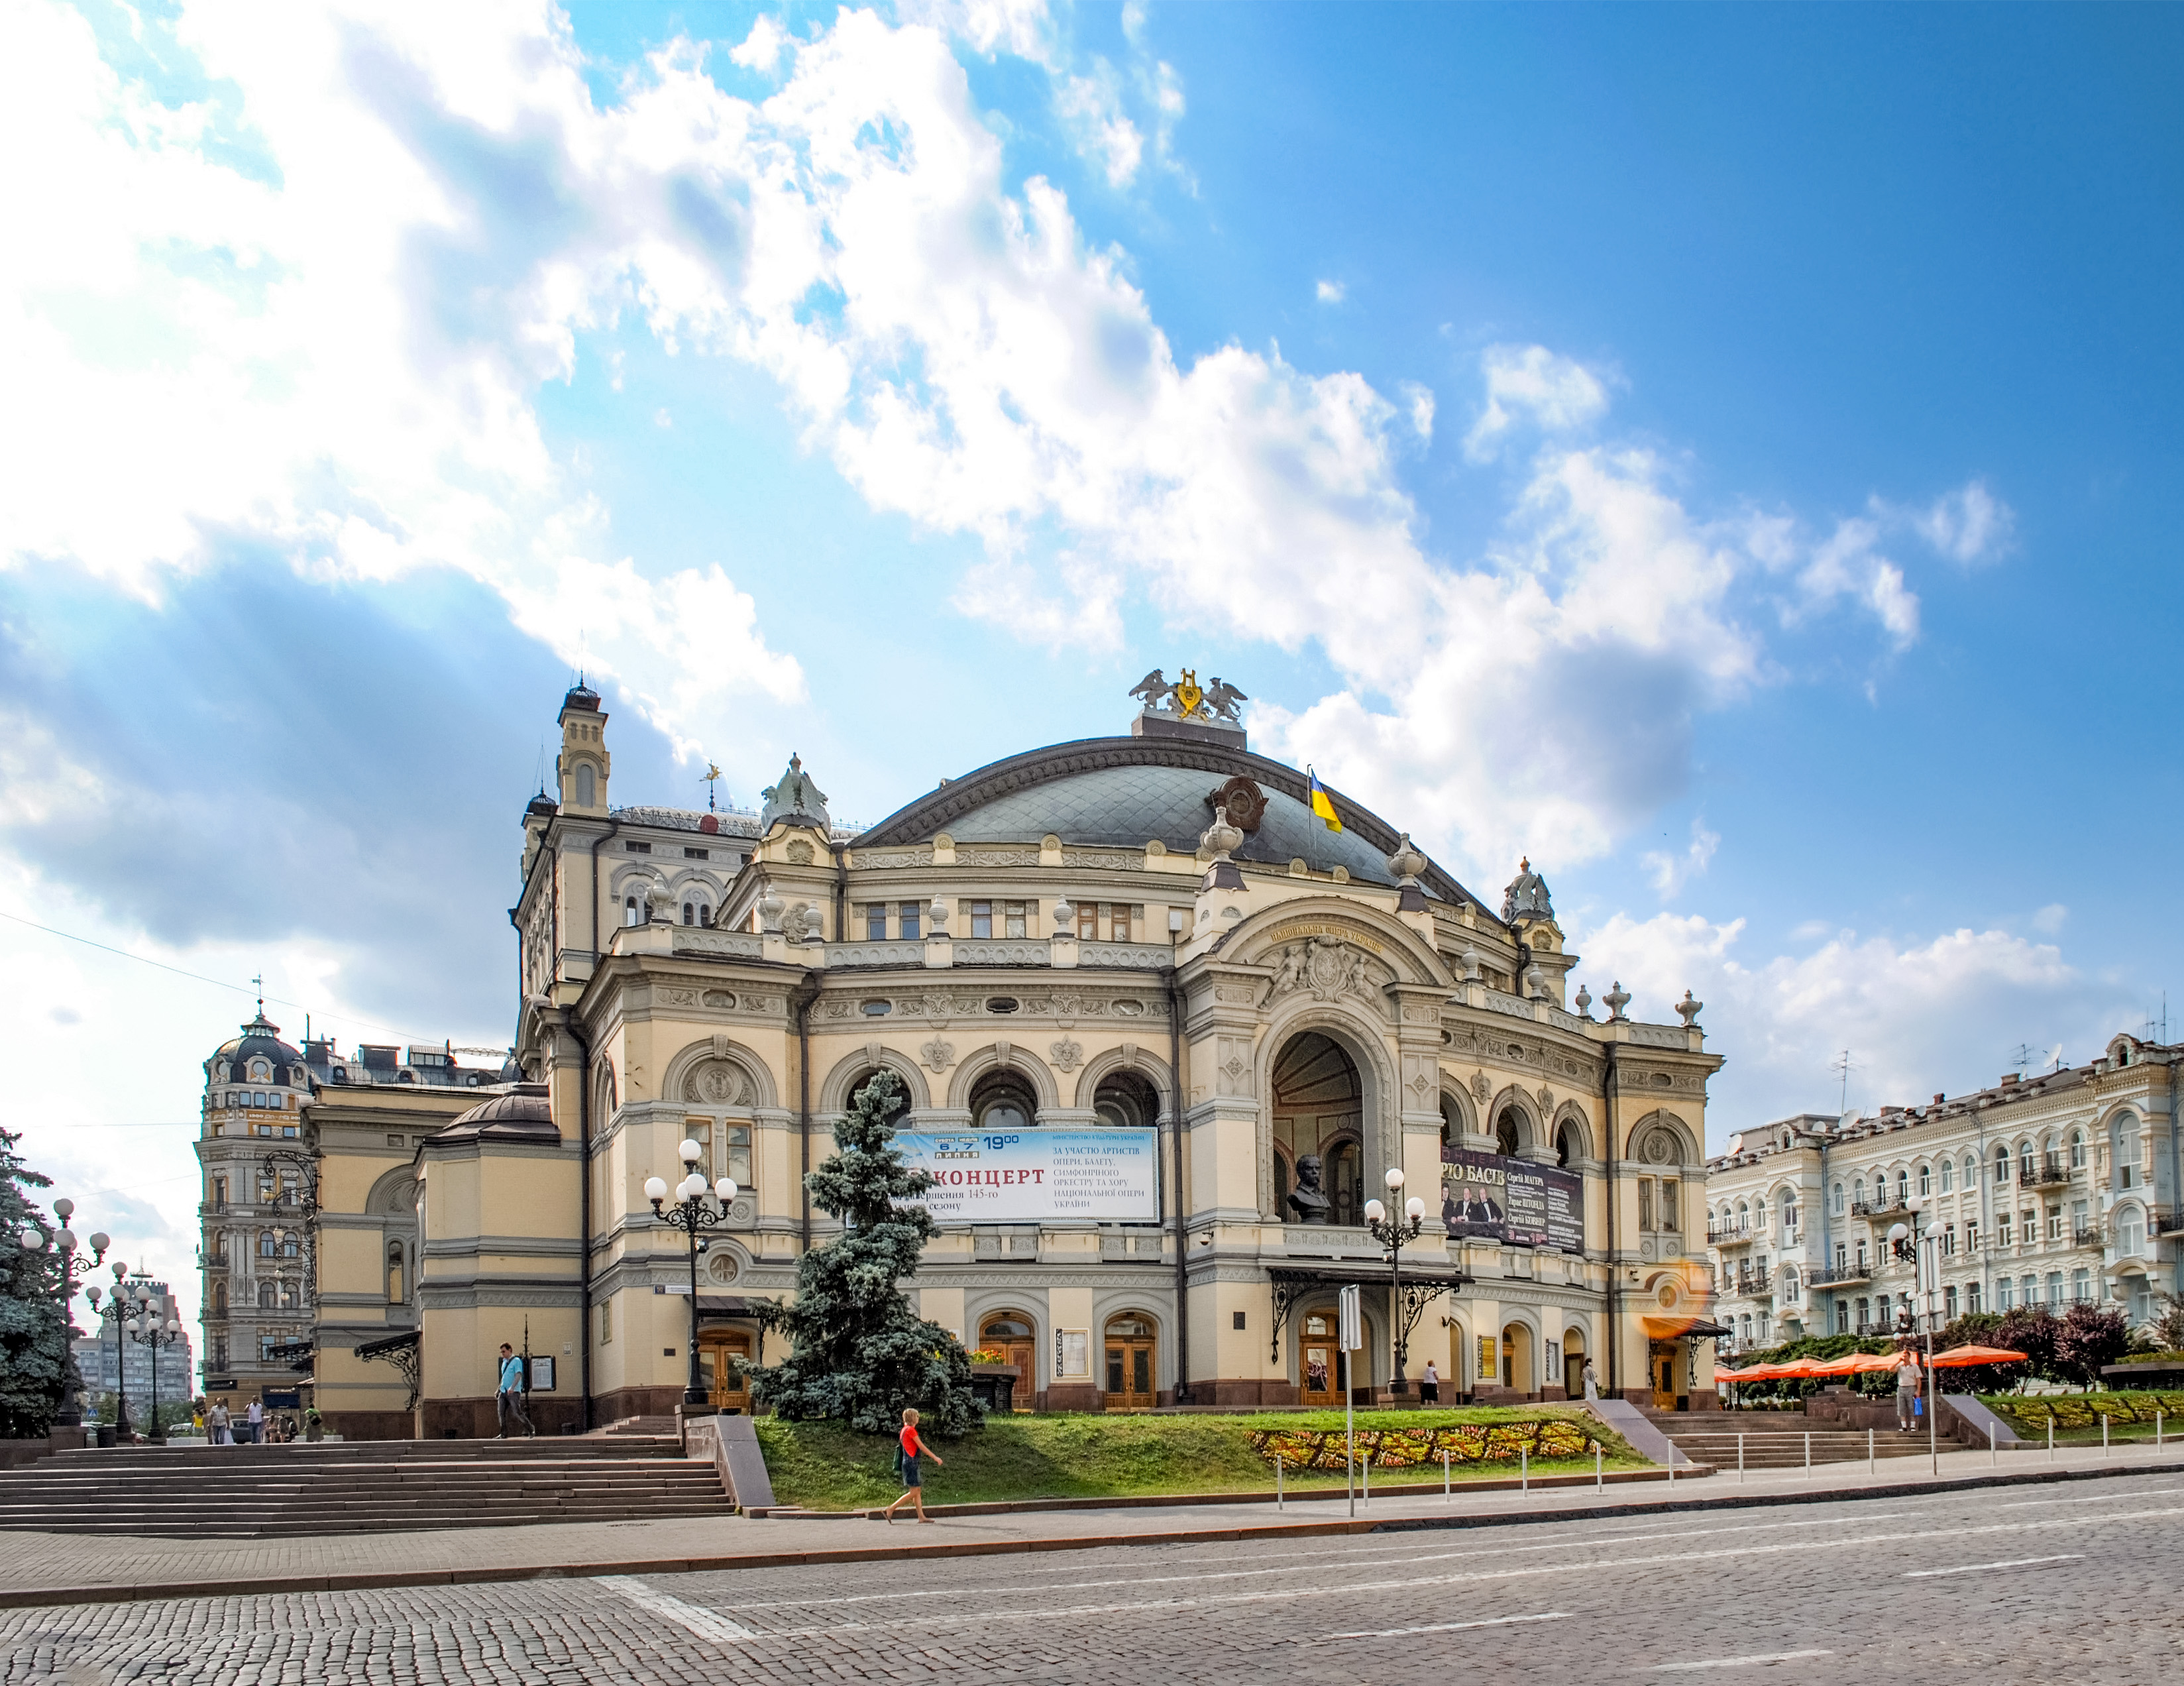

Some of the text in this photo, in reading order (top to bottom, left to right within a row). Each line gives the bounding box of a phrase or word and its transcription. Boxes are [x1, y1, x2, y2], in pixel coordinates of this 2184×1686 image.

[1271, 925, 1323, 942] НАЦІОНАЛЬНА
[1325, 926, 1349, 938] ОПЕРА
[933, 1169, 1044, 1188] КОНЦЕРТ
[1441, 1162, 1505, 1186] РІО БАСІВ
[969, 1189, 998, 1199] 145-го
[1054, 1189, 1115, 1198] НАЦІОНАЛЬНОЇ
[929, 1203, 961, 1212] сезону
[1054, 1200, 1090, 1209] УКРАЇНИ
